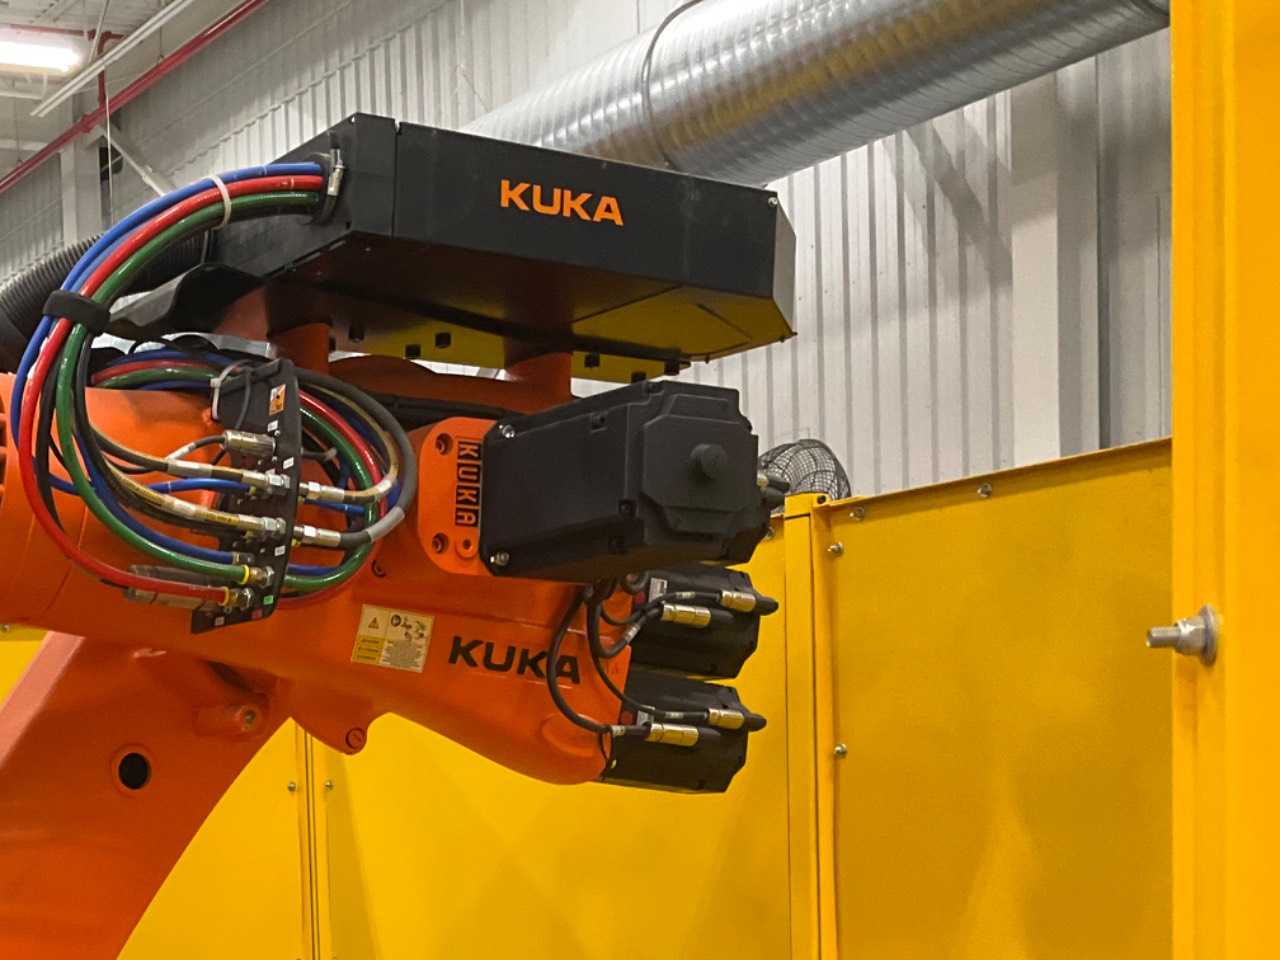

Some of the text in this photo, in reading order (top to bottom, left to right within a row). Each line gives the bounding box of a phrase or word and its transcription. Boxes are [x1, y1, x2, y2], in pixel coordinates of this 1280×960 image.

[500, 178, 625, 227] KUKA
[456, 441, 480, 527] KUKA
[448, 635, 581, 685] KUKA
